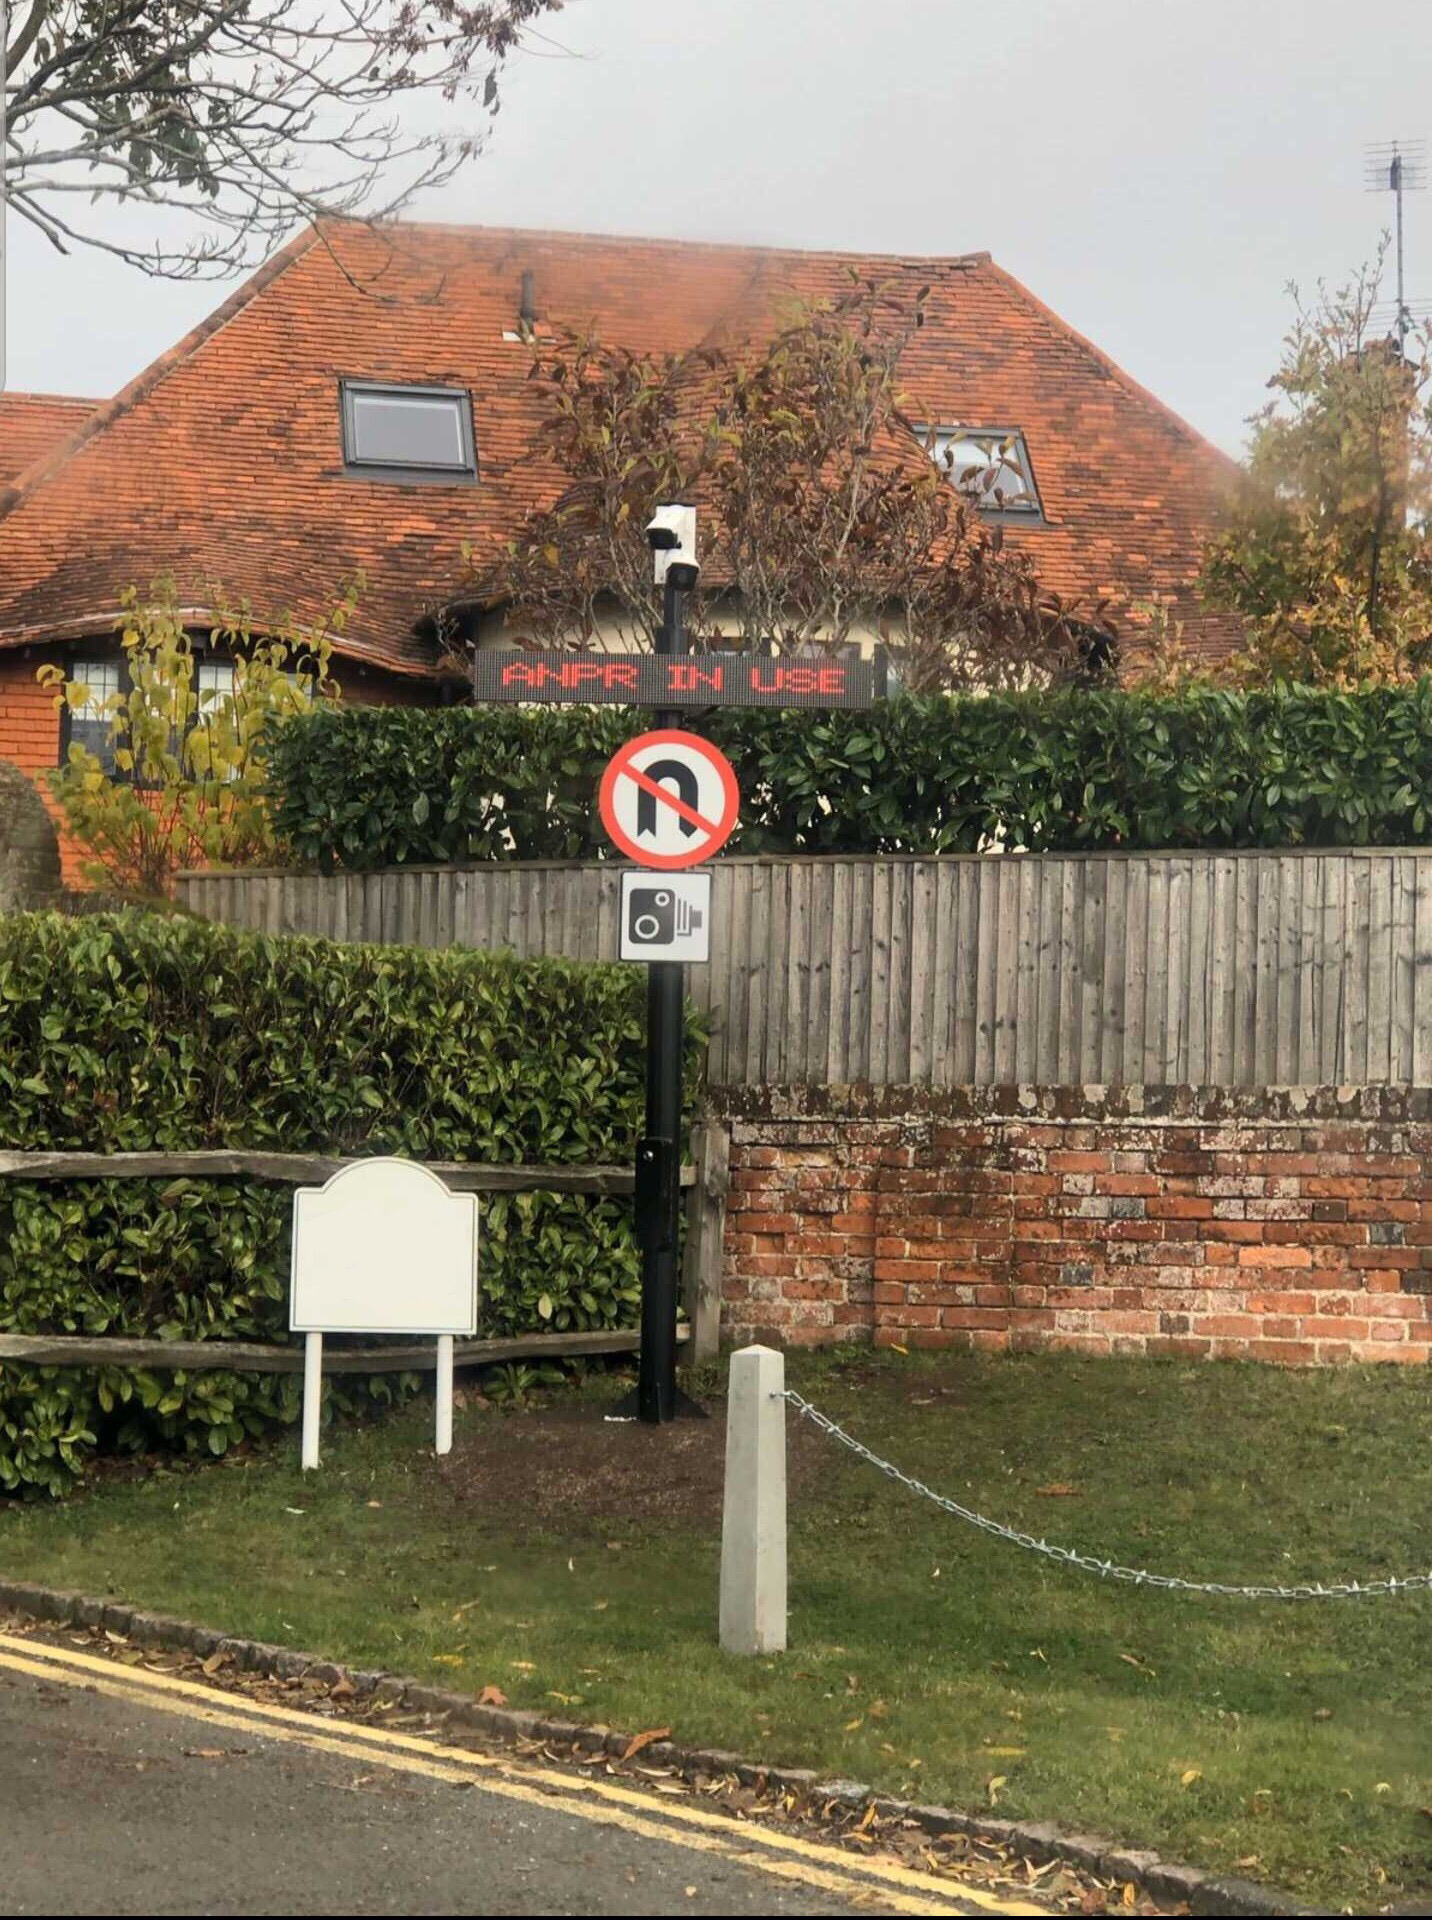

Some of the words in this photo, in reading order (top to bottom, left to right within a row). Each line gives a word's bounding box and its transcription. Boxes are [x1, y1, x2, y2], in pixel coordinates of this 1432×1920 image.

[502, 662, 638, 690] ANPR
[667, 663, 723, 691] IN
[751, 666, 845, 694] USE
